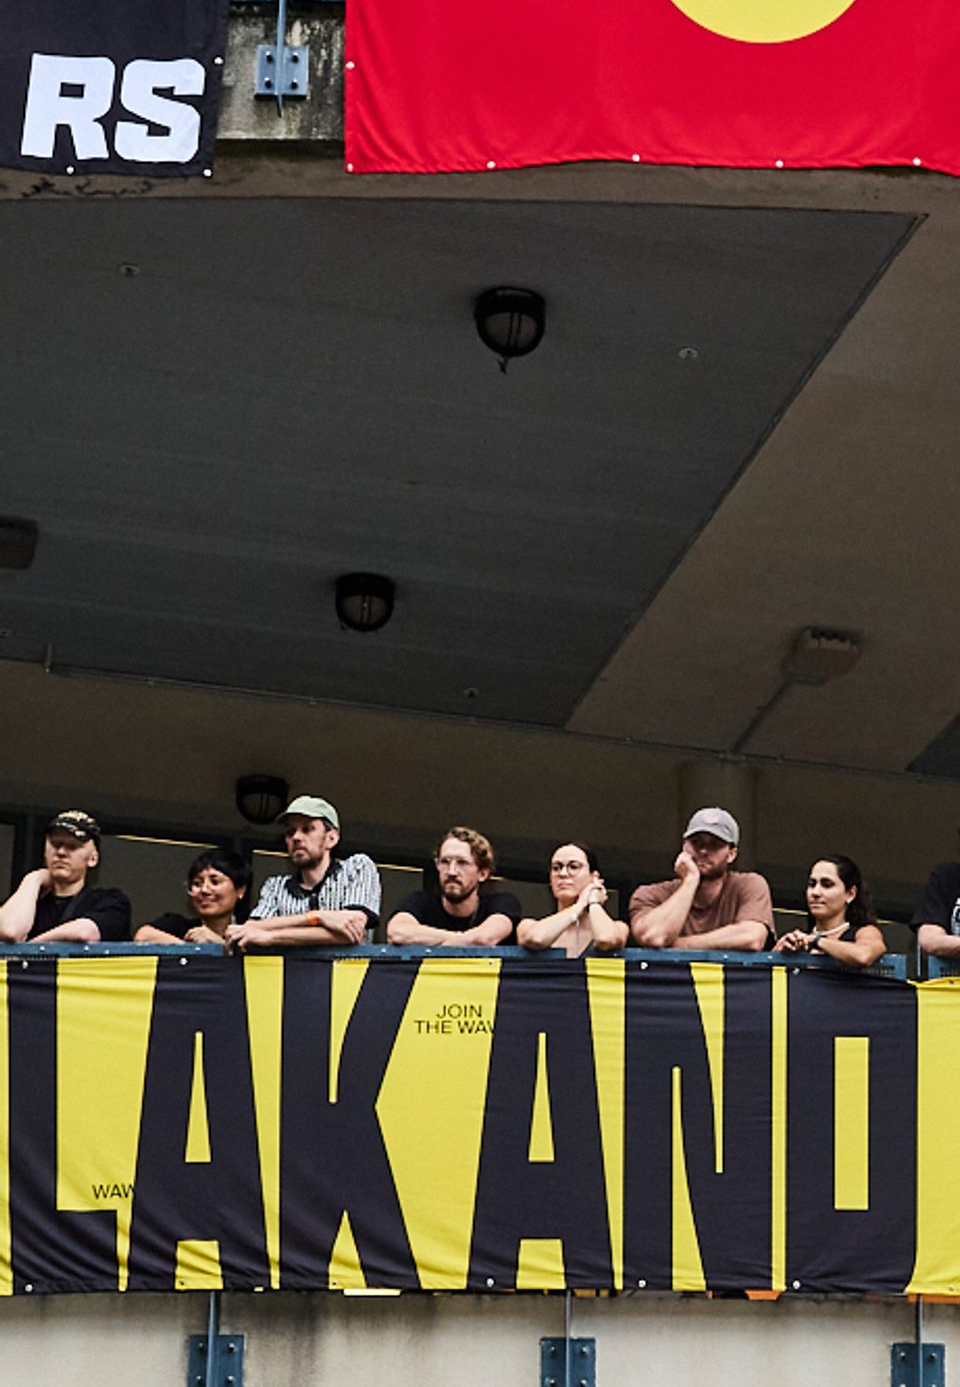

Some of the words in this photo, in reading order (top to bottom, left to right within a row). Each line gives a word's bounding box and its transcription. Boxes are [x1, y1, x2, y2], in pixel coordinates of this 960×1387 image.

[20, 53, 206, 164] RS
[414, 1020, 453, 1034] THE
[436, 1004, 483, 1019] JOIN
[466, 956, 918, 1295] AND
